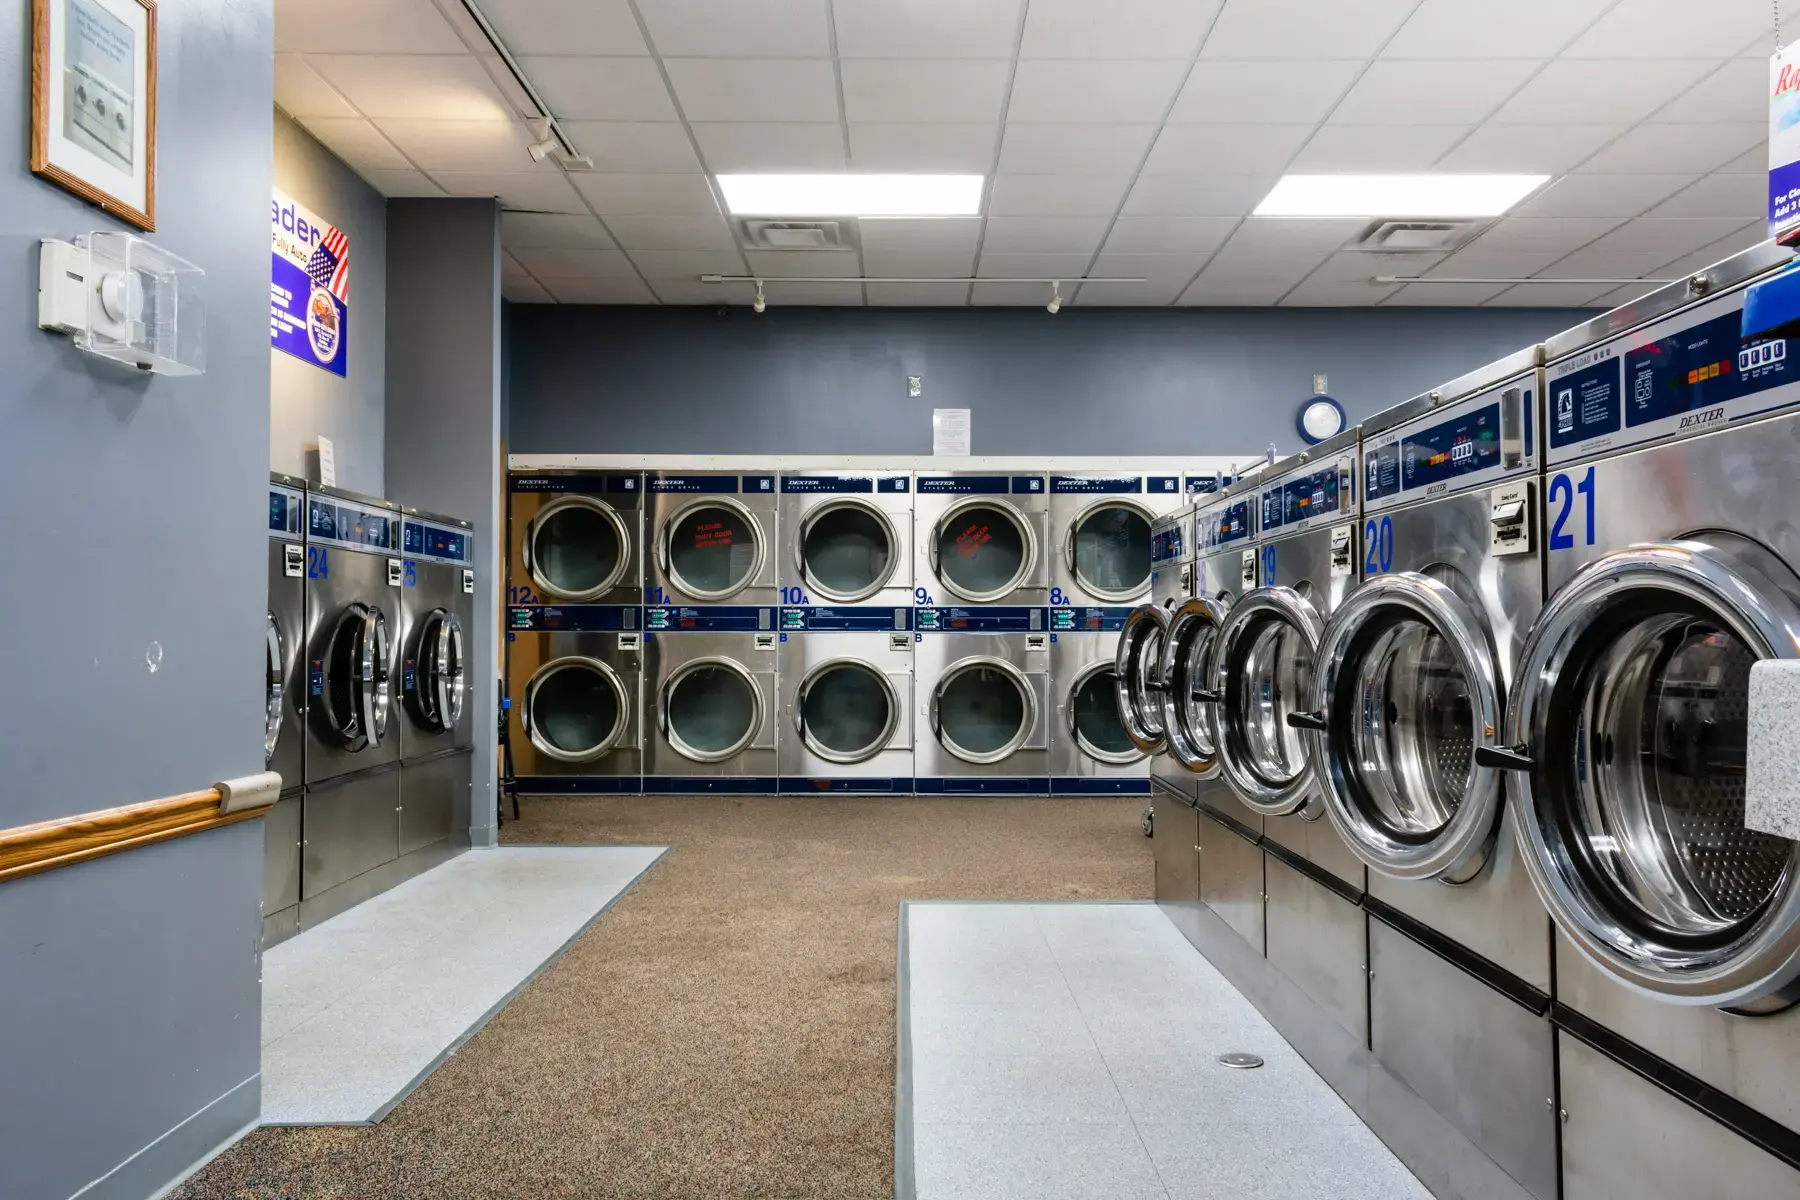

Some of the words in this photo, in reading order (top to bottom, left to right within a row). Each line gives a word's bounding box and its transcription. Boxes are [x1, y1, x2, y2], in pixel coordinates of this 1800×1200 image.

[1774, 195, 1788, 206] For
[1774, 203, 1790, 219] Add
[1790, 200, 1797, 211] 3
[272, 232, 288, 255] Fully
[290, 245, 307, 263] Auto
[1576, 354, 1591, 368] LOAD
[1679, 407, 1724, 429] DEXTER
[1549, 466, 1595, 551] 21
[1365, 515, 1394, 574] 20
[308, 547, 328, 579] 24
[1261, 544, 1276, 587] 19
[402, 560, 416, 588] 25
[779, 586, 810, 605] 10A
[915, 587, 934, 605] 9A
[1050, 587, 1070, 605] 8A
[779, 633, 788, 642] B
[915, 634, 923, 643] B
[1050, 634, 1058, 643] B
